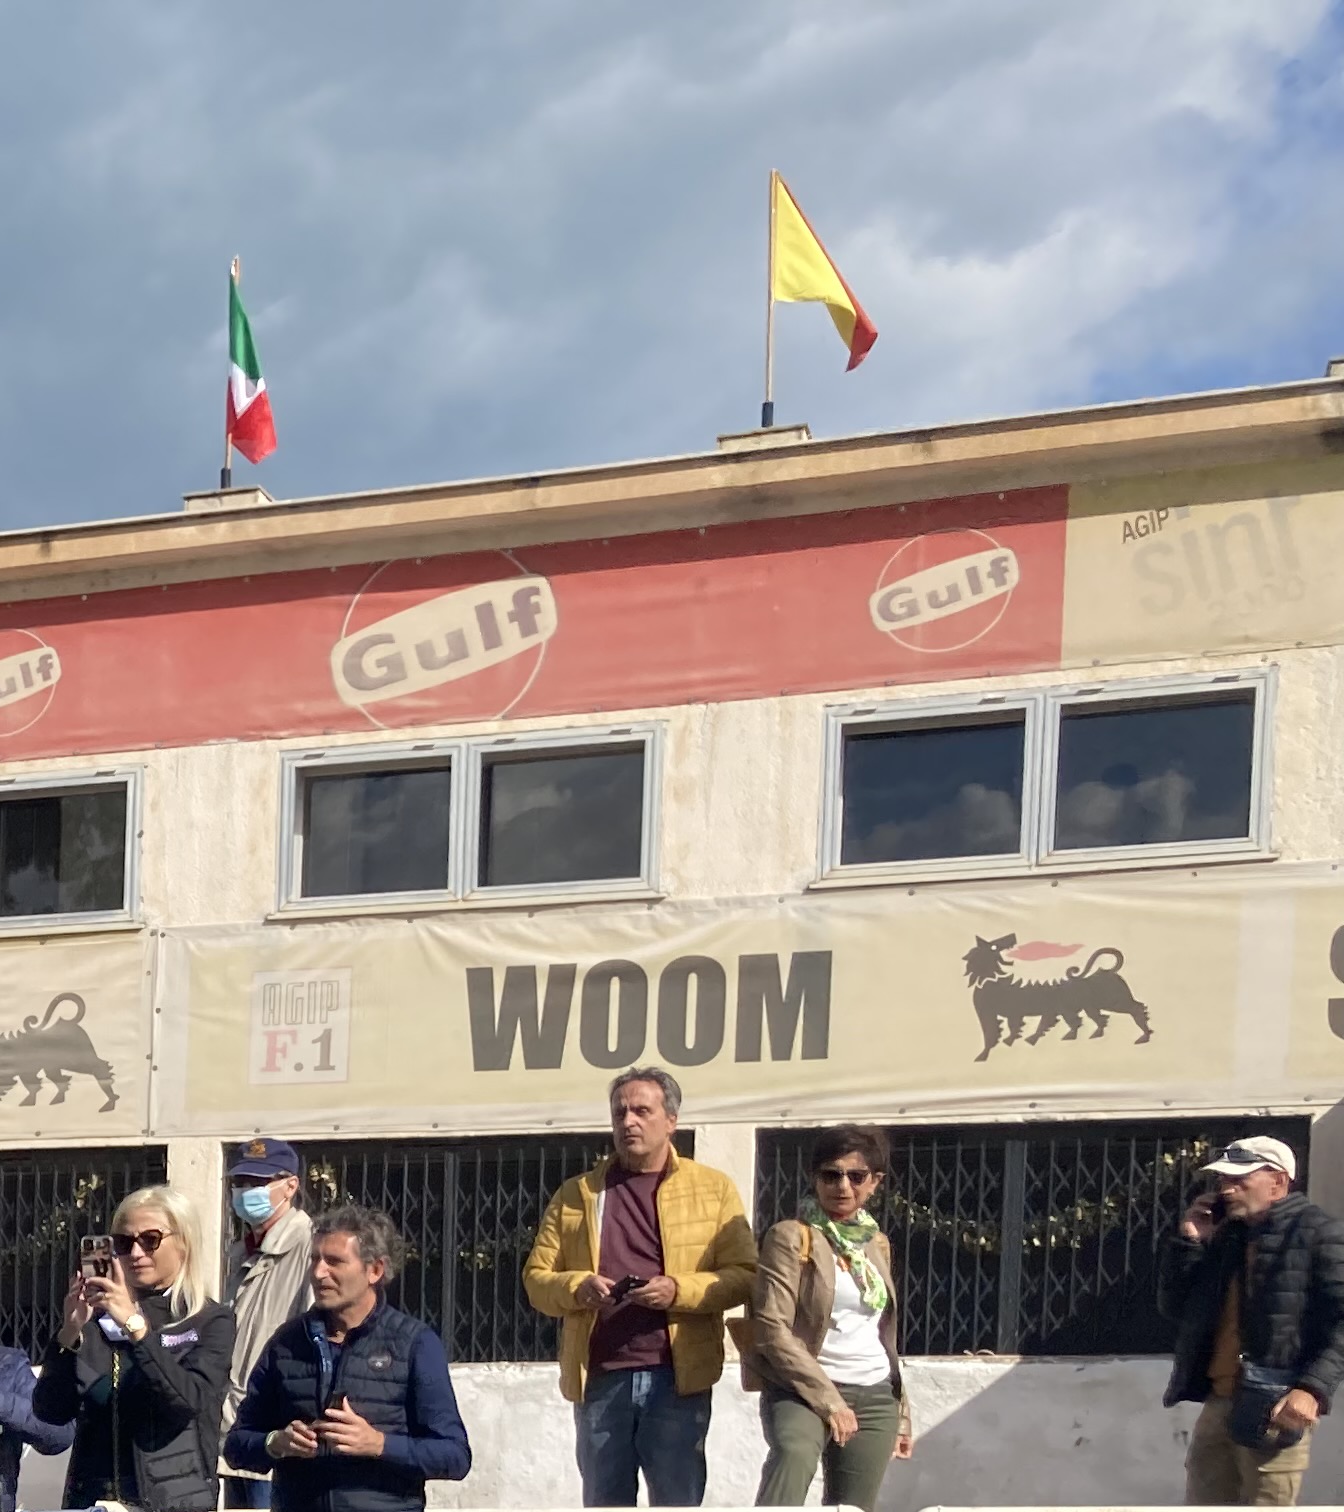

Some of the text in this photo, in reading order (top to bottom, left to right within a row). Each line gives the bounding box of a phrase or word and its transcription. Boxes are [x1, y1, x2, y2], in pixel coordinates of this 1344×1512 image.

[1121, 508, 1170, 544] AGIP
[876, 557, 1012, 624] Gulf
[341, 586, 543, 693] Gulf
[261, 980, 340, 1027] AGIP
[466, 949, 833, 1072] WOOM
[258, 1028, 337, 1073] F.1
